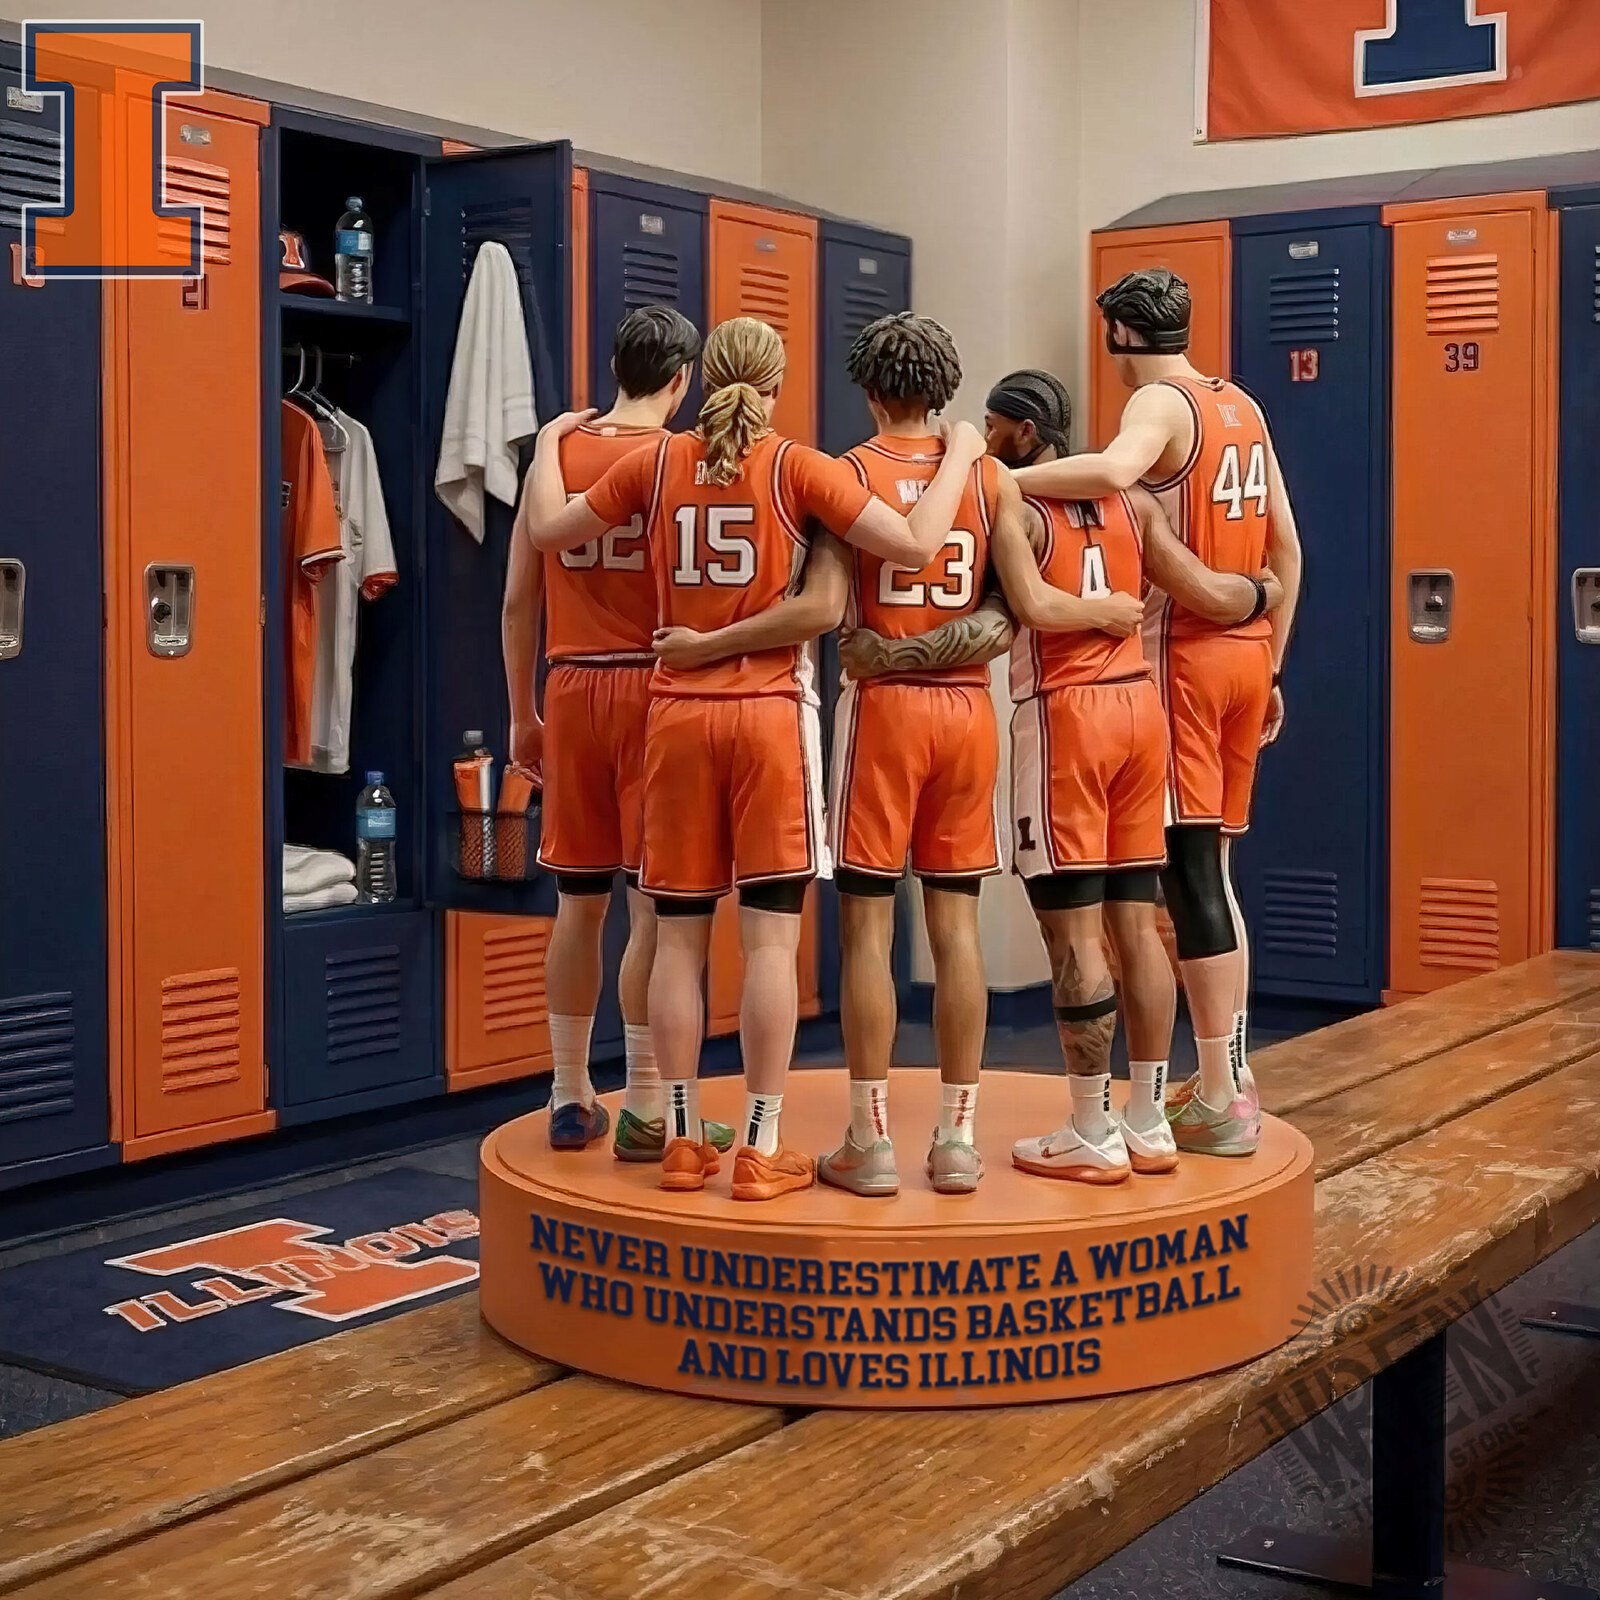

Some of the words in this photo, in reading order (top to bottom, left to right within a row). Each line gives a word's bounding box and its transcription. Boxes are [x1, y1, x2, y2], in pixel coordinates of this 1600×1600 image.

[1212, 441, 1268, 520] 44
[672, 504, 758, 587] 15
[530, 1213, 671, 1278] NEVER
[680, 1246, 1041, 1297] UNDERESTIMATE
[1050, 1250, 1078, 1286] A
[1088, 1213, 1249, 1281] WOMAN
[538, 1262, 634, 1317] WHO
[643, 1285, 958, 1343] UNDERSTANDS
[966, 1264, 1241, 1340] BASKETBALL
[677, 1339, 768, 1383] AND
[776, 1349, 910, 1389] LOVES
[918, 1338, 1101, 1389] ILLINOIS
